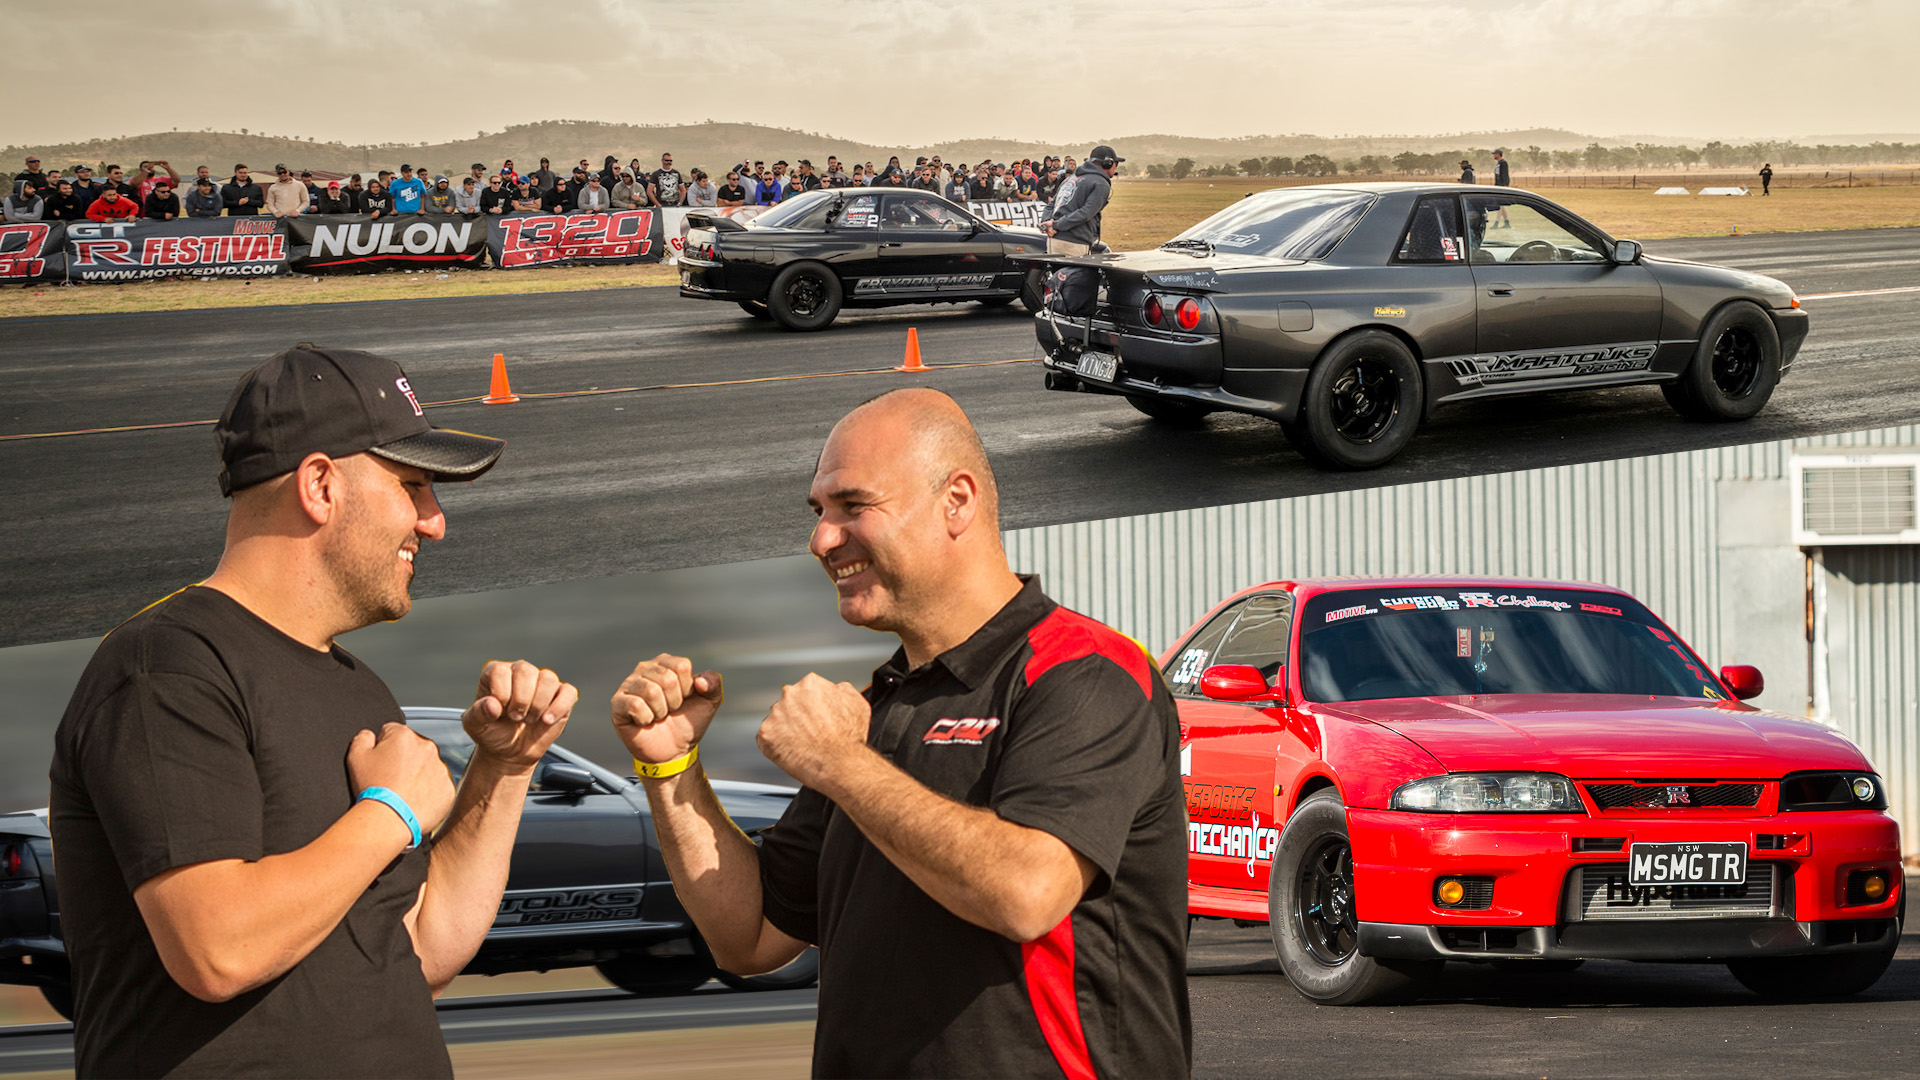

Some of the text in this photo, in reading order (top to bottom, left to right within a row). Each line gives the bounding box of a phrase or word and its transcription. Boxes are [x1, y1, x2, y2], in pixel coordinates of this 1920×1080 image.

[867, 214, 879, 228] 2
[309, 222, 472, 257] NULON
[499, 209, 654, 253] 1320
[140, 234, 287, 266] FESTIVAL
[82, 264, 278, 281] WWW.MOTIVEDVD.COM
[1572, 360, 1648, 375] RACING
[1496, 595, 1571, 611] Challenge
[1326, 605, 1366, 622] MOTIVE
[1172, 649, 1204, 684] 33
[1633, 853, 1740, 881] MSMGTR
[519, 907, 638, 923] RACING
